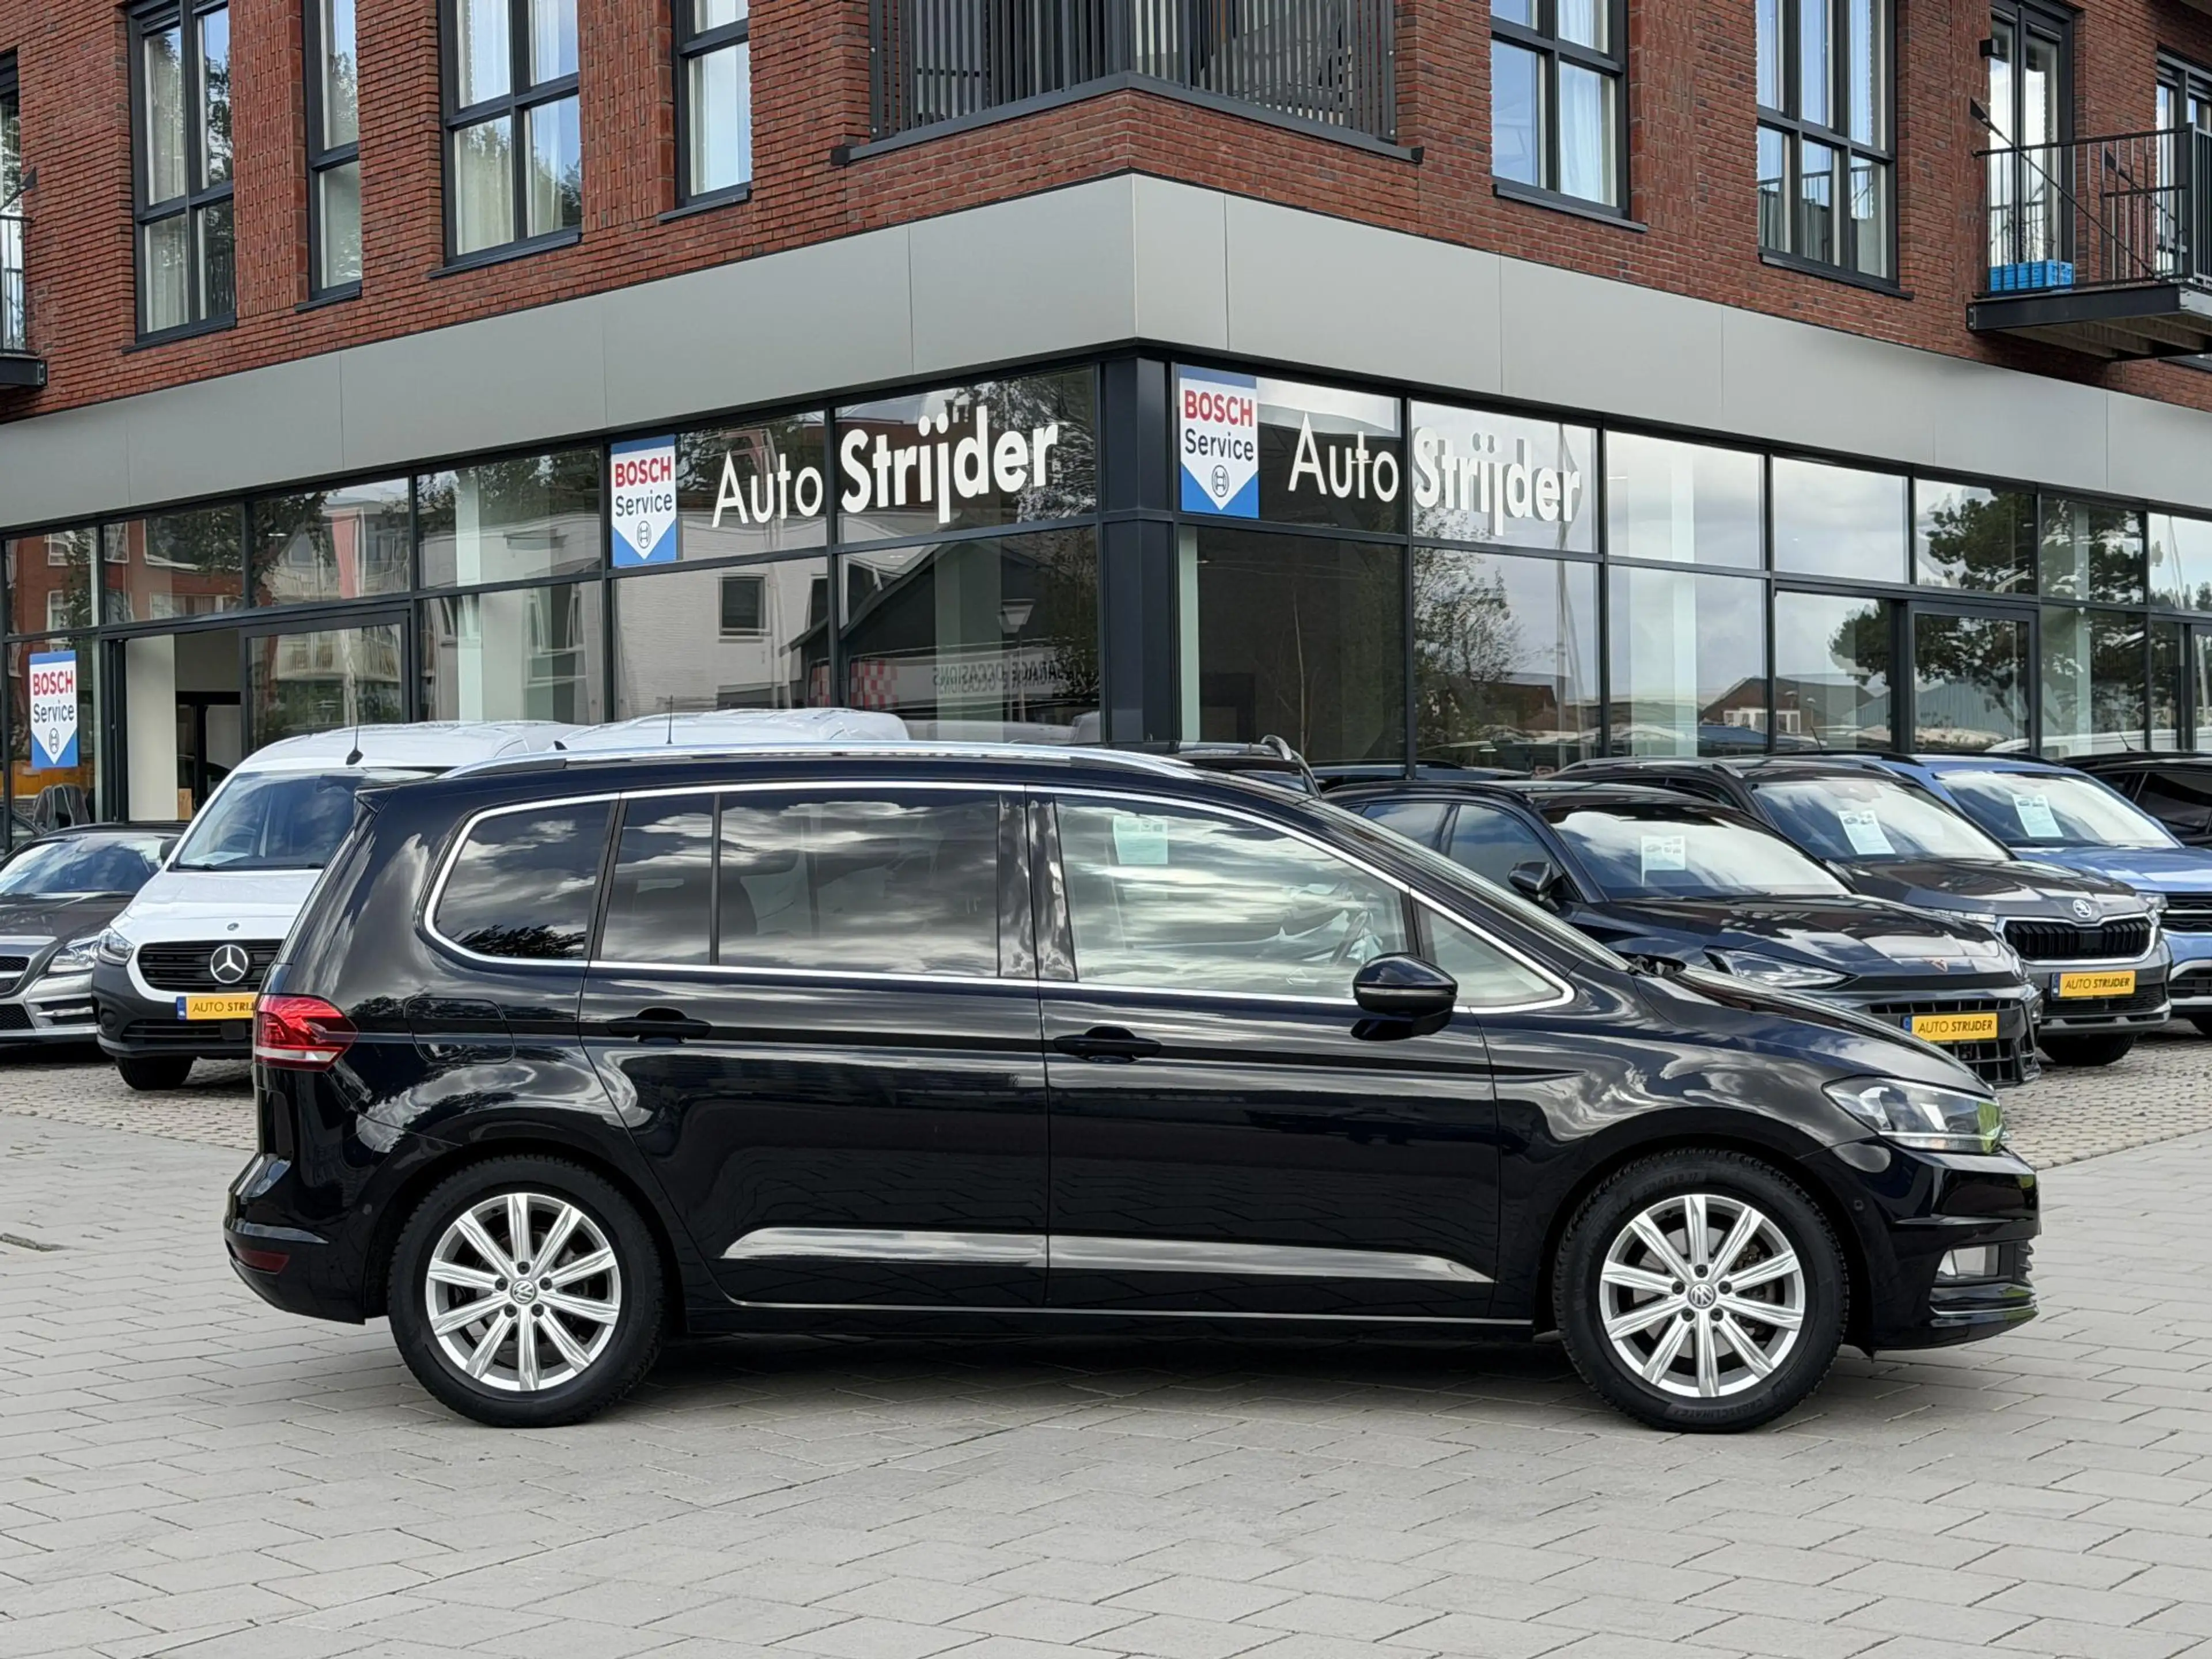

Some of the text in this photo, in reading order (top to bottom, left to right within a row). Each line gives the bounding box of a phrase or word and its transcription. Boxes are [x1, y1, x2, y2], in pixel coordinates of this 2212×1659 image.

[1184, 389, 1253, 427] BOSCH
[1185, 428, 1253, 461] Service
[615, 456, 672, 488] BOSCH
[712, 406, 1058, 528] Auto Strijder
[1288, 412, 1581, 536] Auto Strijder
[615, 489, 673, 517] Service
[33, 670, 74, 696] BOSCH
[33, 699, 75, 724] Service
[2065, 978, 2092, 990] AUTO
[192, 1002, 224, 1012] AUTO
[1918, 1021, 1949, 1033] AUTO
